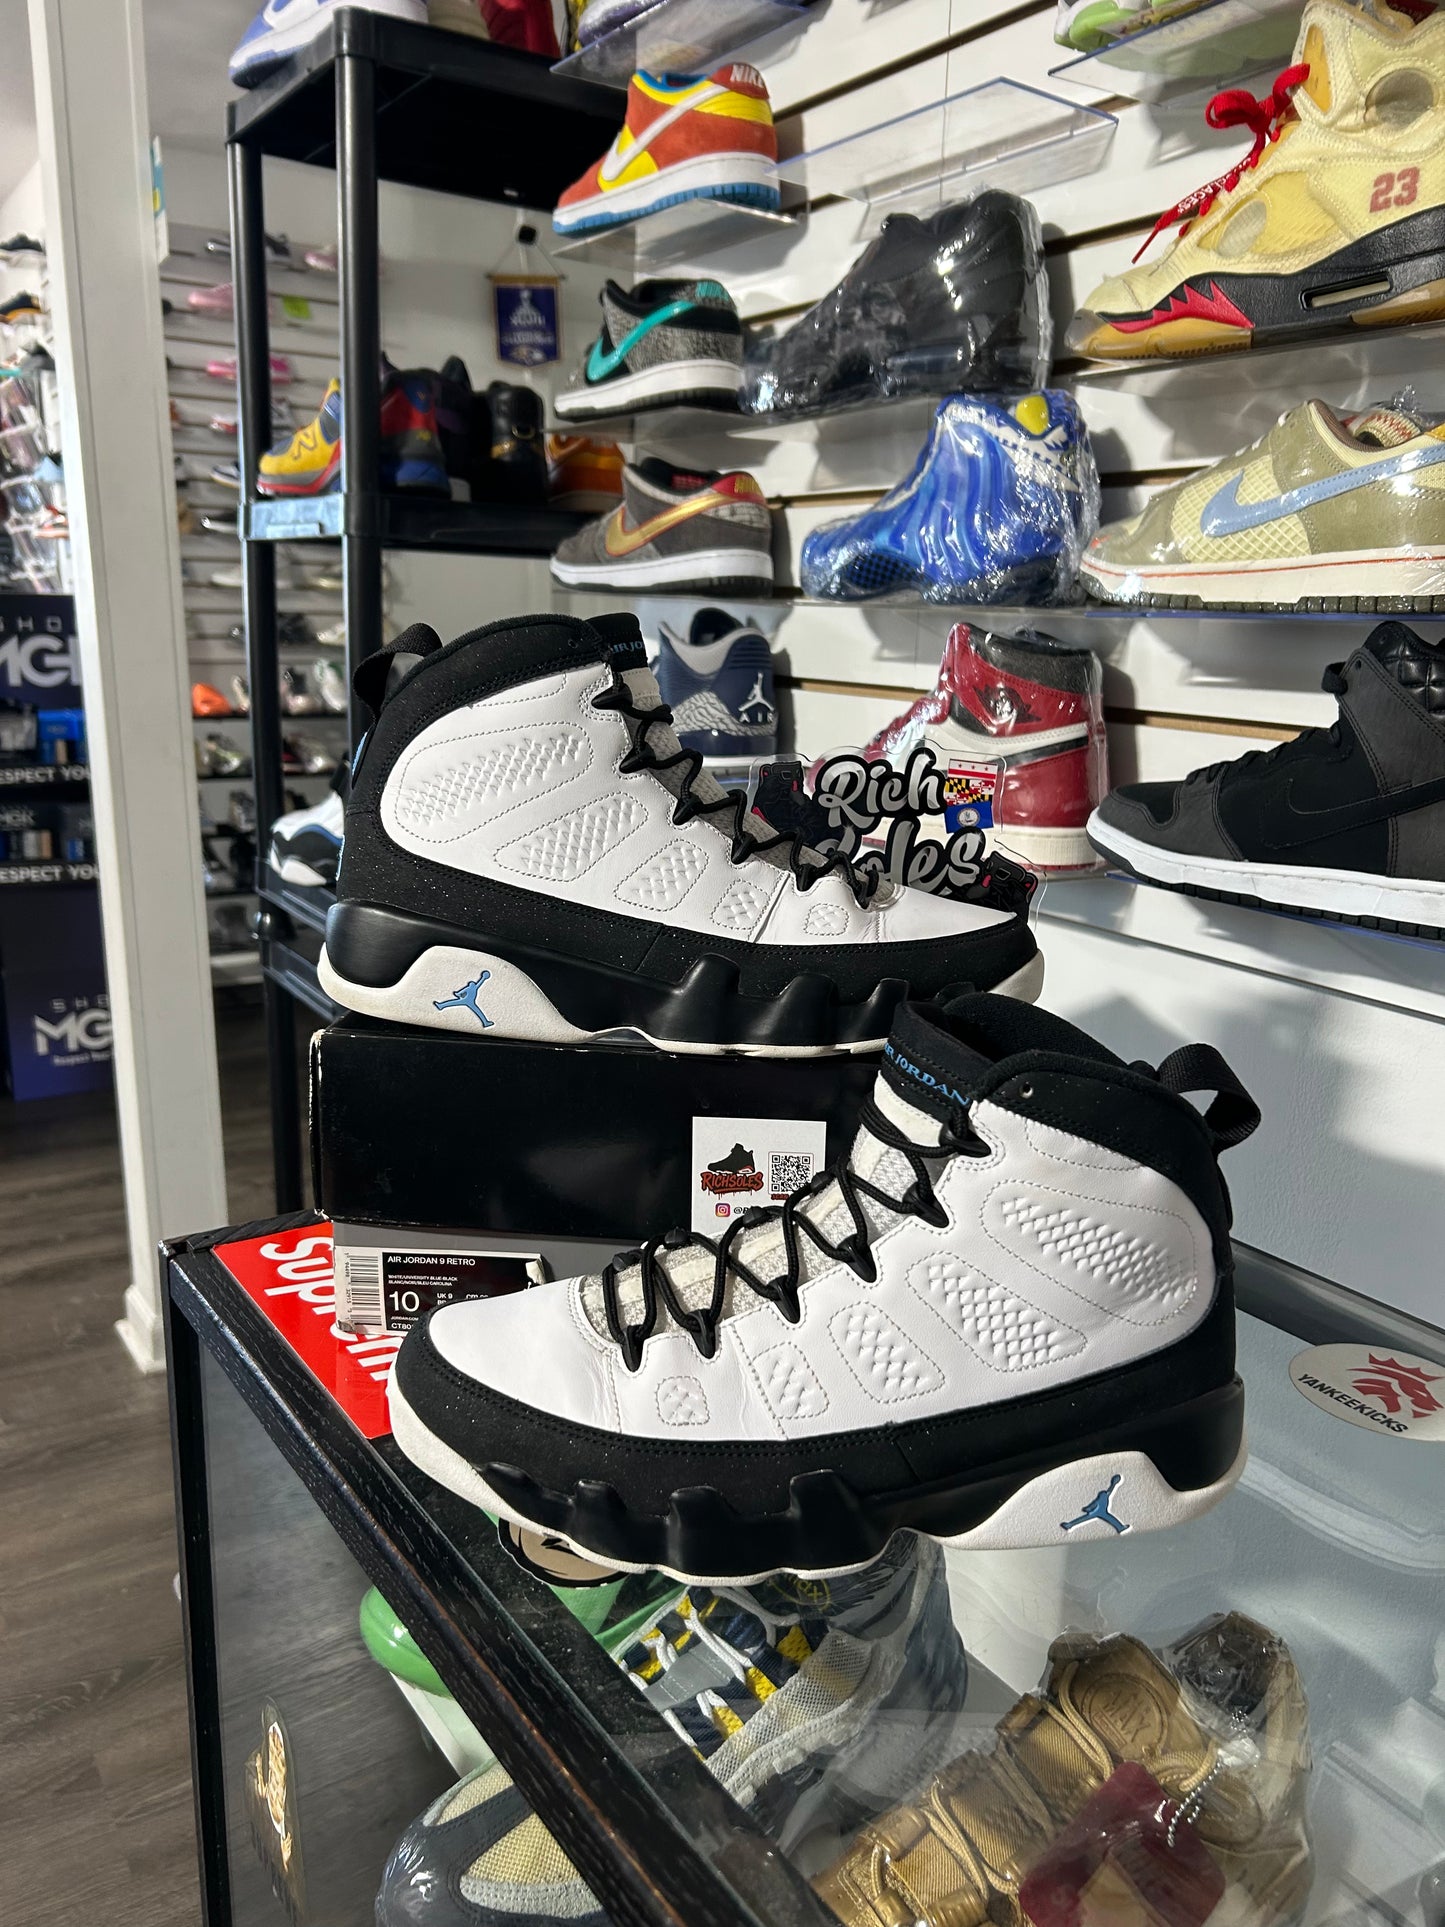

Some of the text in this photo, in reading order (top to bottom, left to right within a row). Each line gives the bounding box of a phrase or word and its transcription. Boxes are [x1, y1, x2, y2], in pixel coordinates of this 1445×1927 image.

[1369, 166, 1420, 213] 23
[815, 750, 944, 831] Rich
[0, 865, 62, 884] ESPECT
[34, 1008, 112, 1056] MG
[895, 1053, 970, 1105] JORDAN
[701, 1171, 764, 1192] RICHSOLES
[387, 1255, 401, 1263] AIR
[403, 1256, 437, 1264] JORDAN
[446, 1257, 476, 1266] RETRO
[389, 1290, 420, 1312] 10
[391, 1322, 414, 1330] CT80
[1297, 1373, 1409, 1433] YANKEEKICKS
